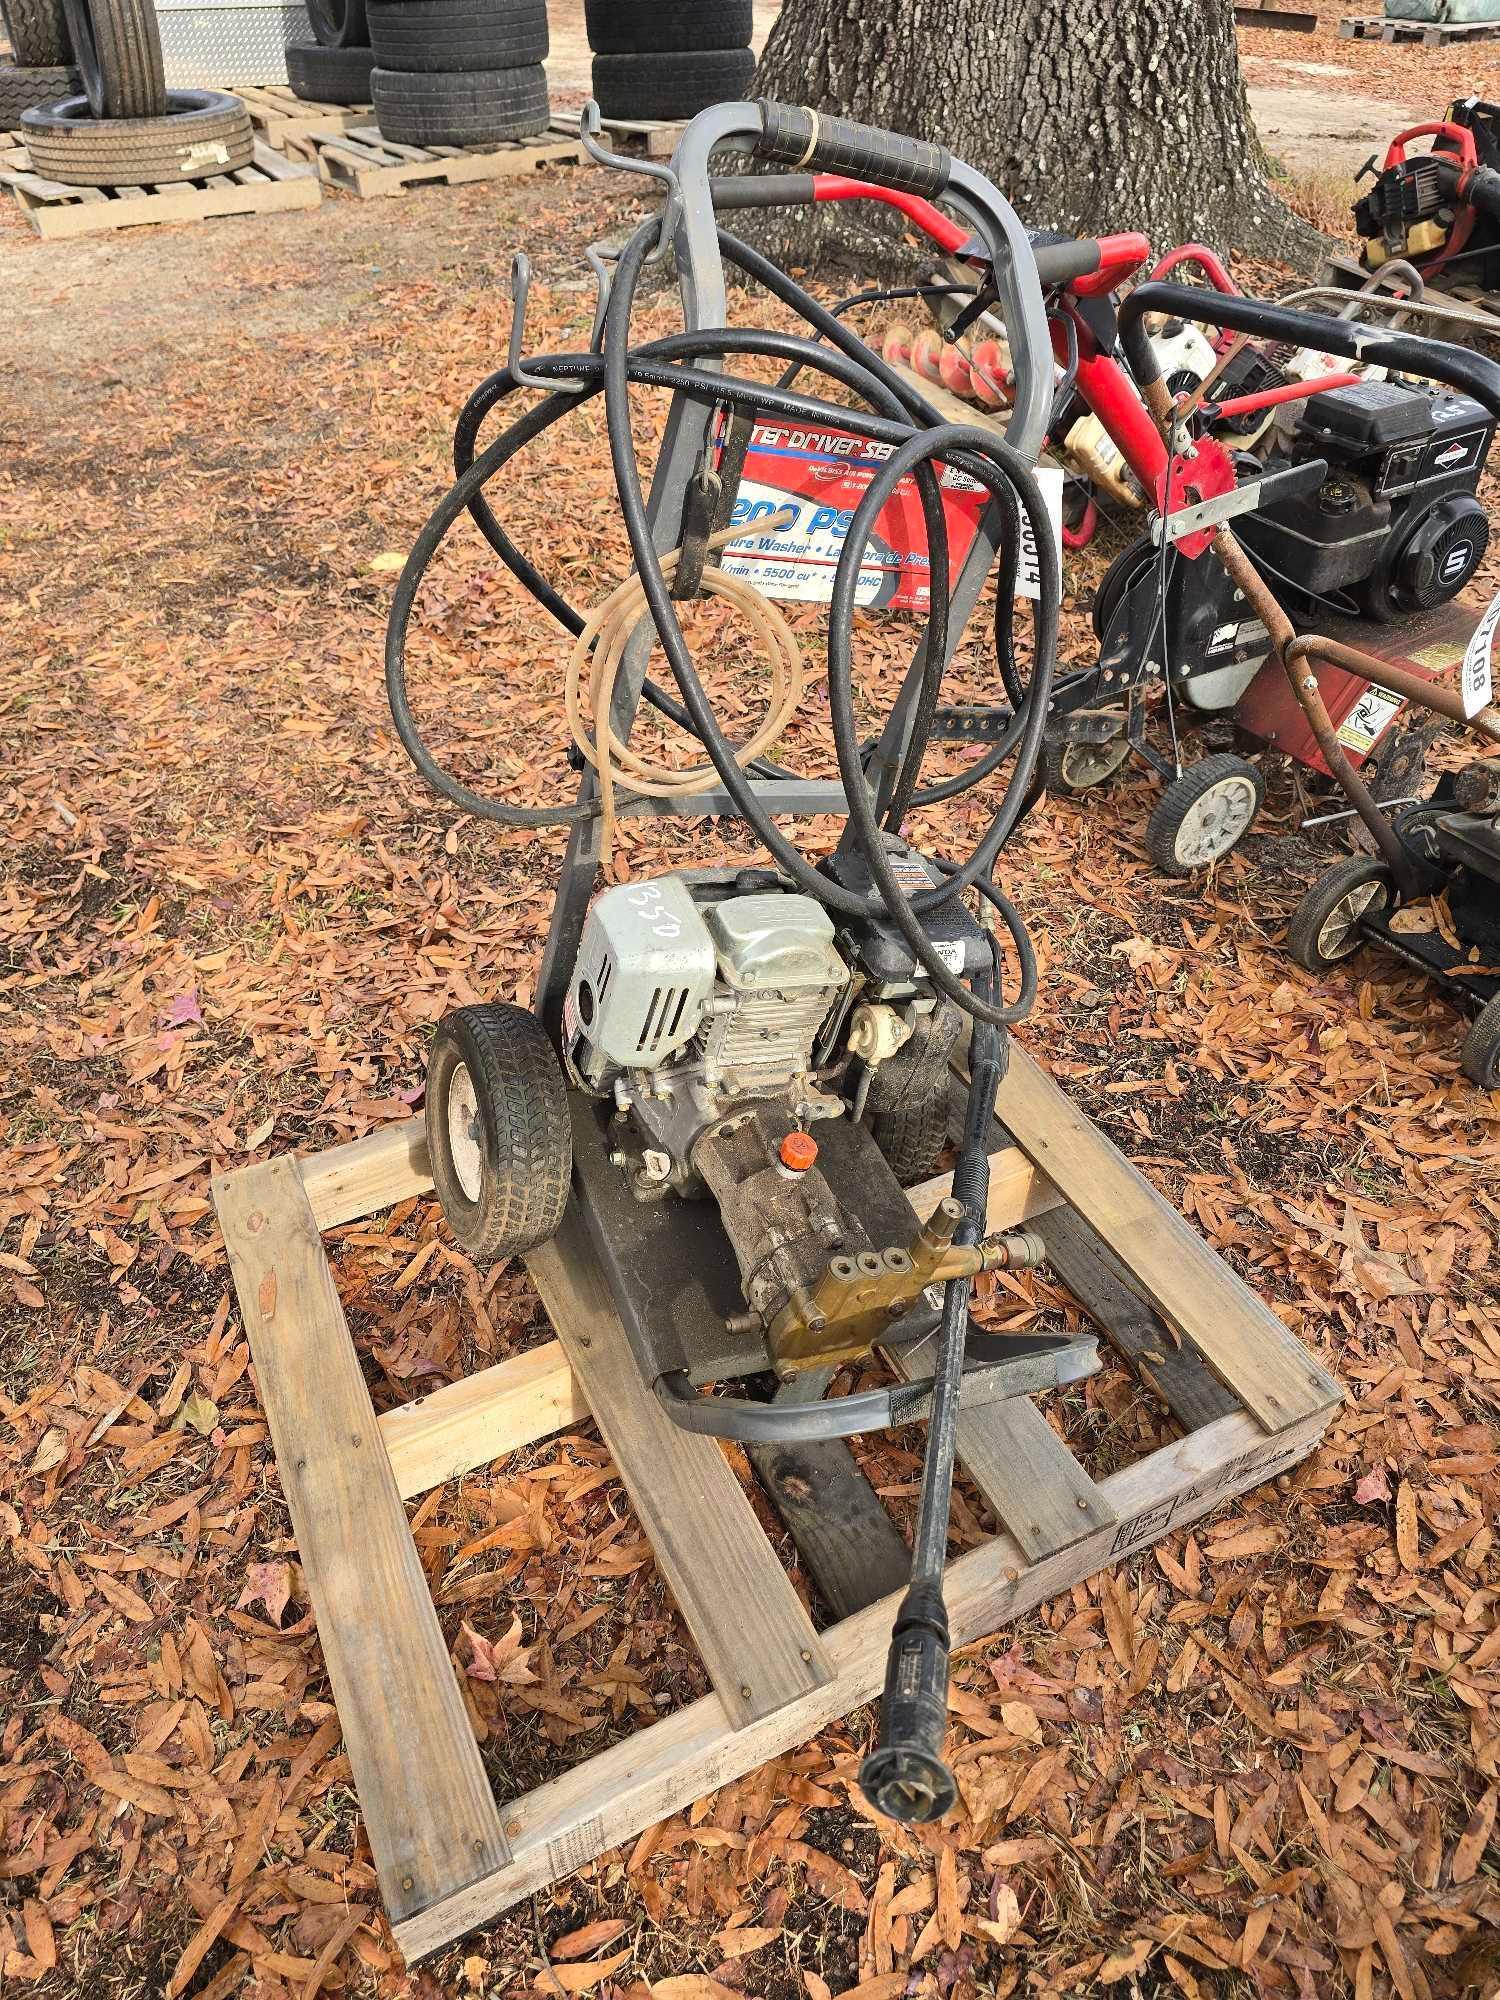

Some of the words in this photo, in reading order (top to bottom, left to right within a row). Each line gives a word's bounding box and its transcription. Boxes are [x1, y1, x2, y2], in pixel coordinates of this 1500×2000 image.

[729, 498, 801, 532] 200
[806, 506, 856, 538] PS
[758, 538, 811, 554] Washer
[886, 550, 903, 564] de
[763, 567, 796, 579] 5500
